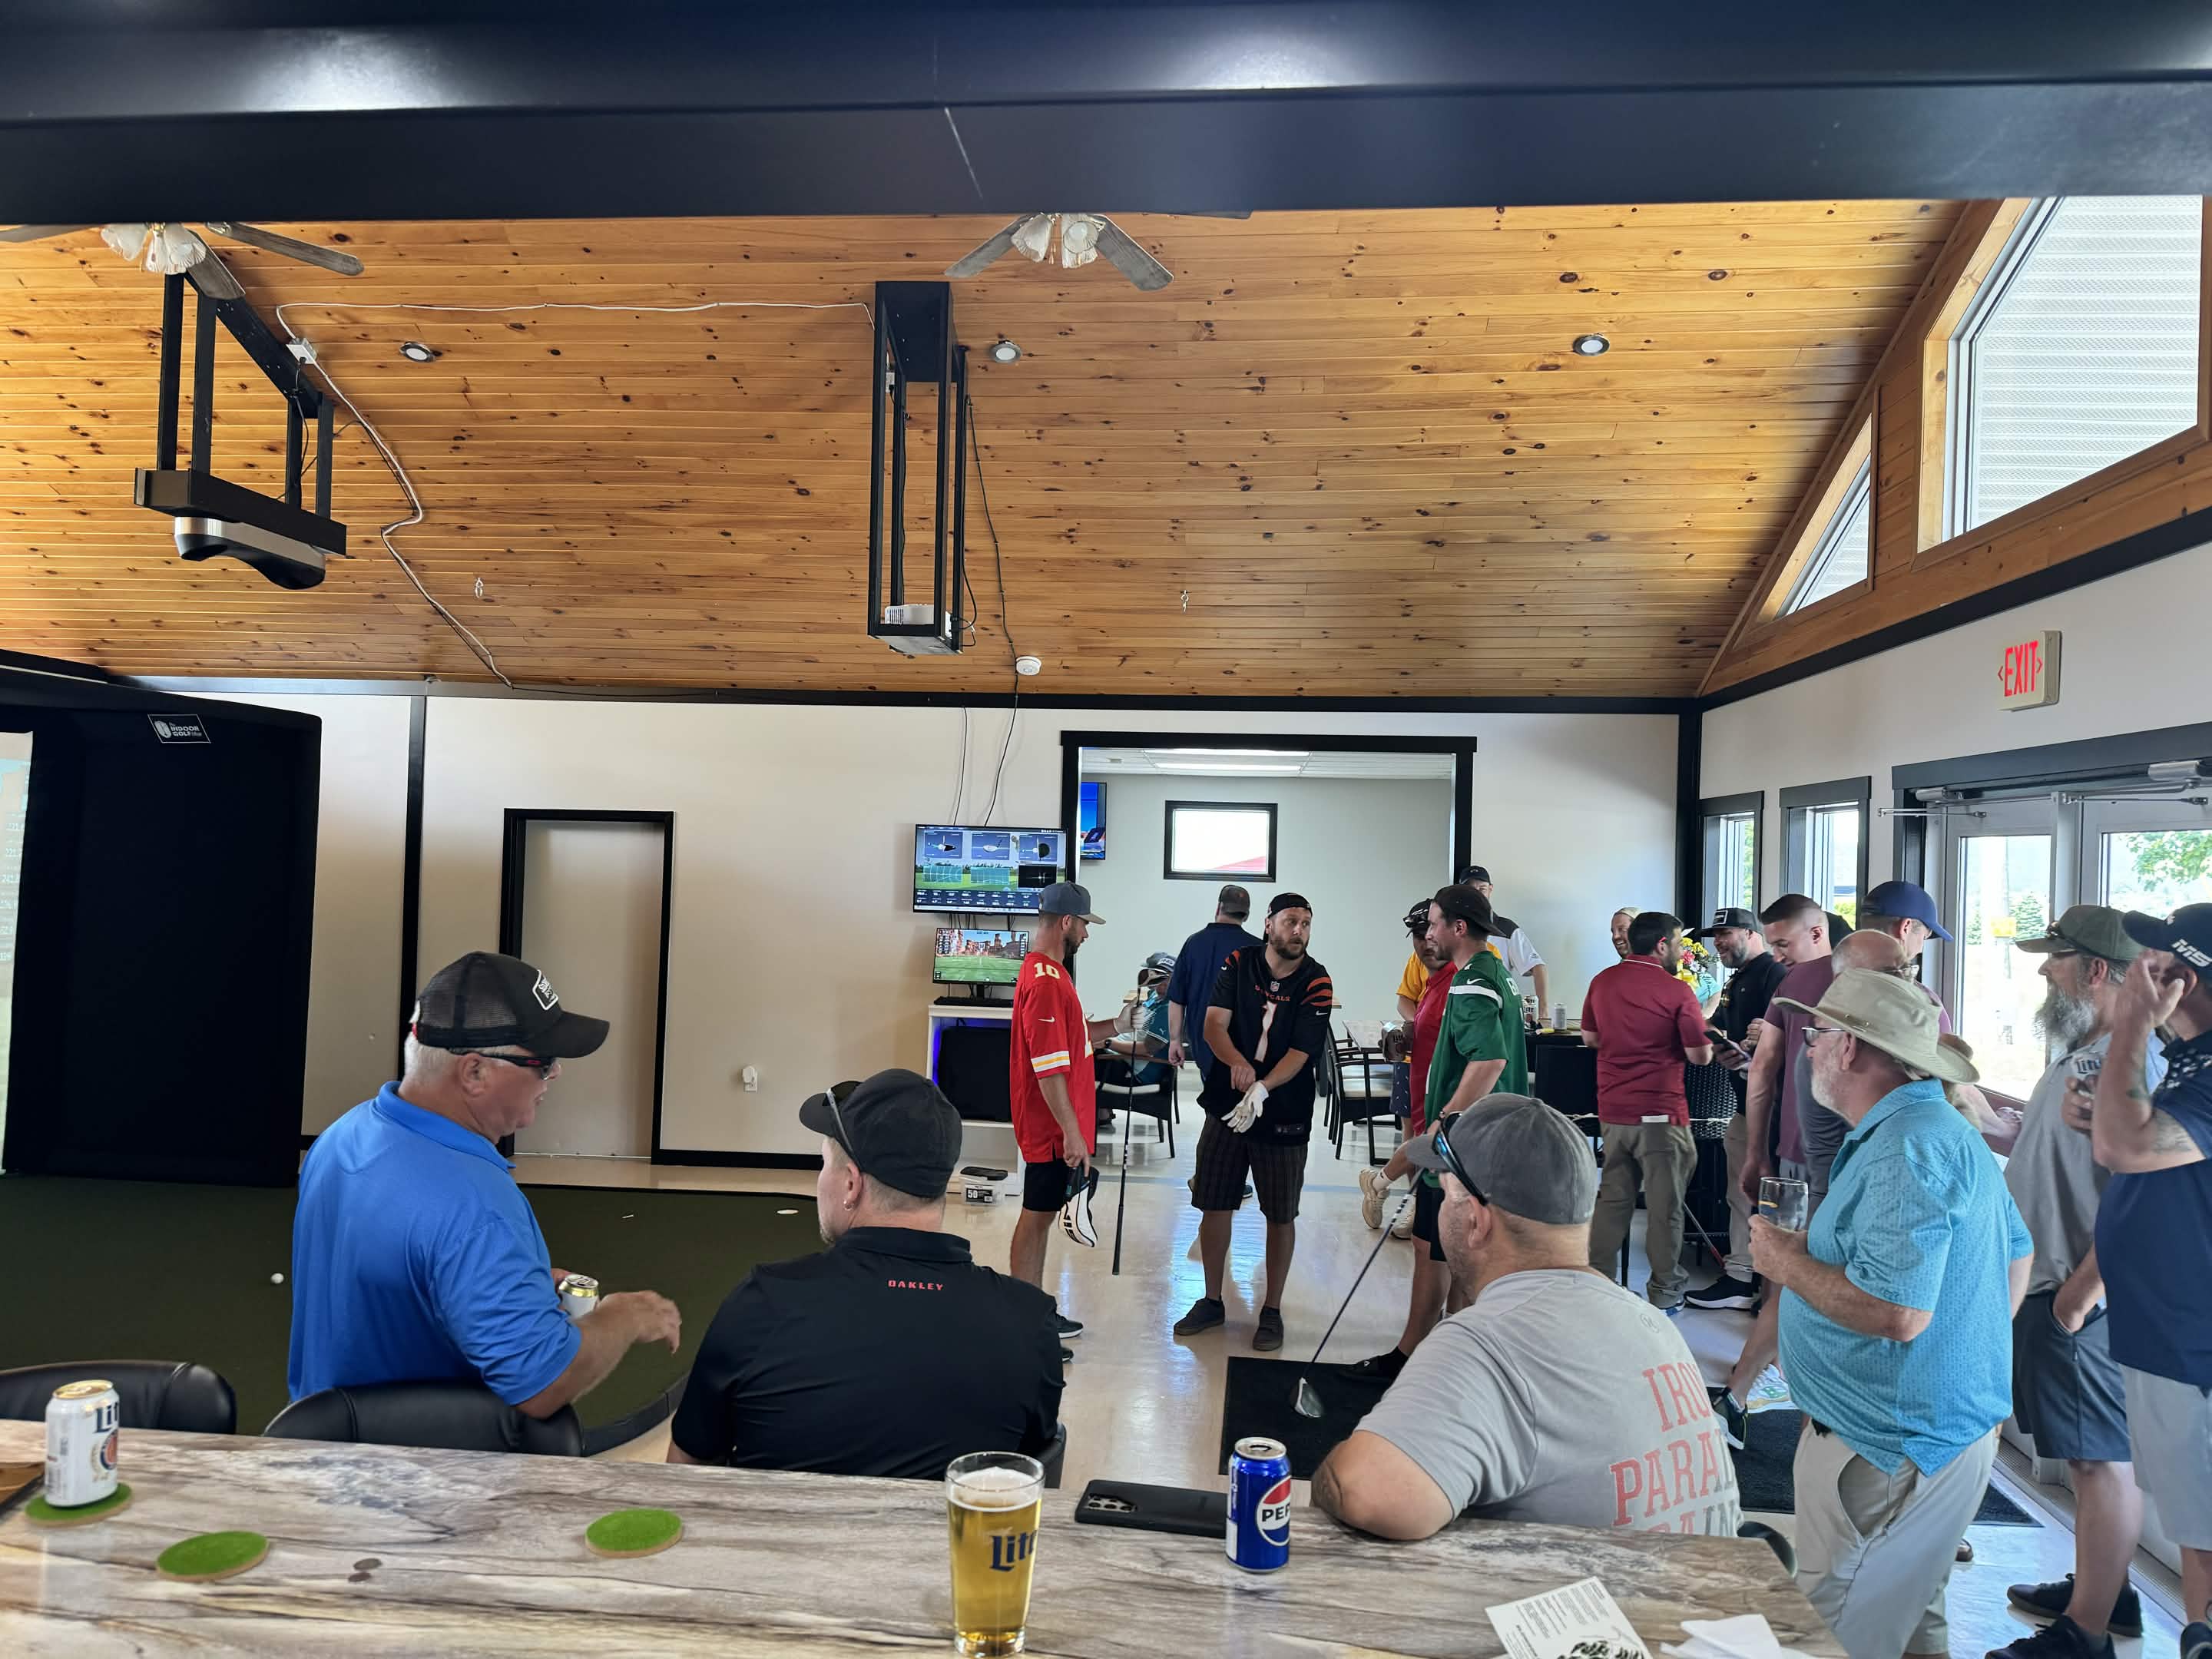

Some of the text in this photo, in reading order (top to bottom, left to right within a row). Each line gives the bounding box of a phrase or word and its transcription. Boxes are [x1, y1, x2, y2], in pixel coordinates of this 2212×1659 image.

[2004, 640, 2038, 697] EXIT
[1034, 962, 1060, 979] 10
[1254, 985, 1291, 1002] BGALS
[968, 1190, 979, 1199] 50
[888, 1280, 944, 1291] OAKLEY
